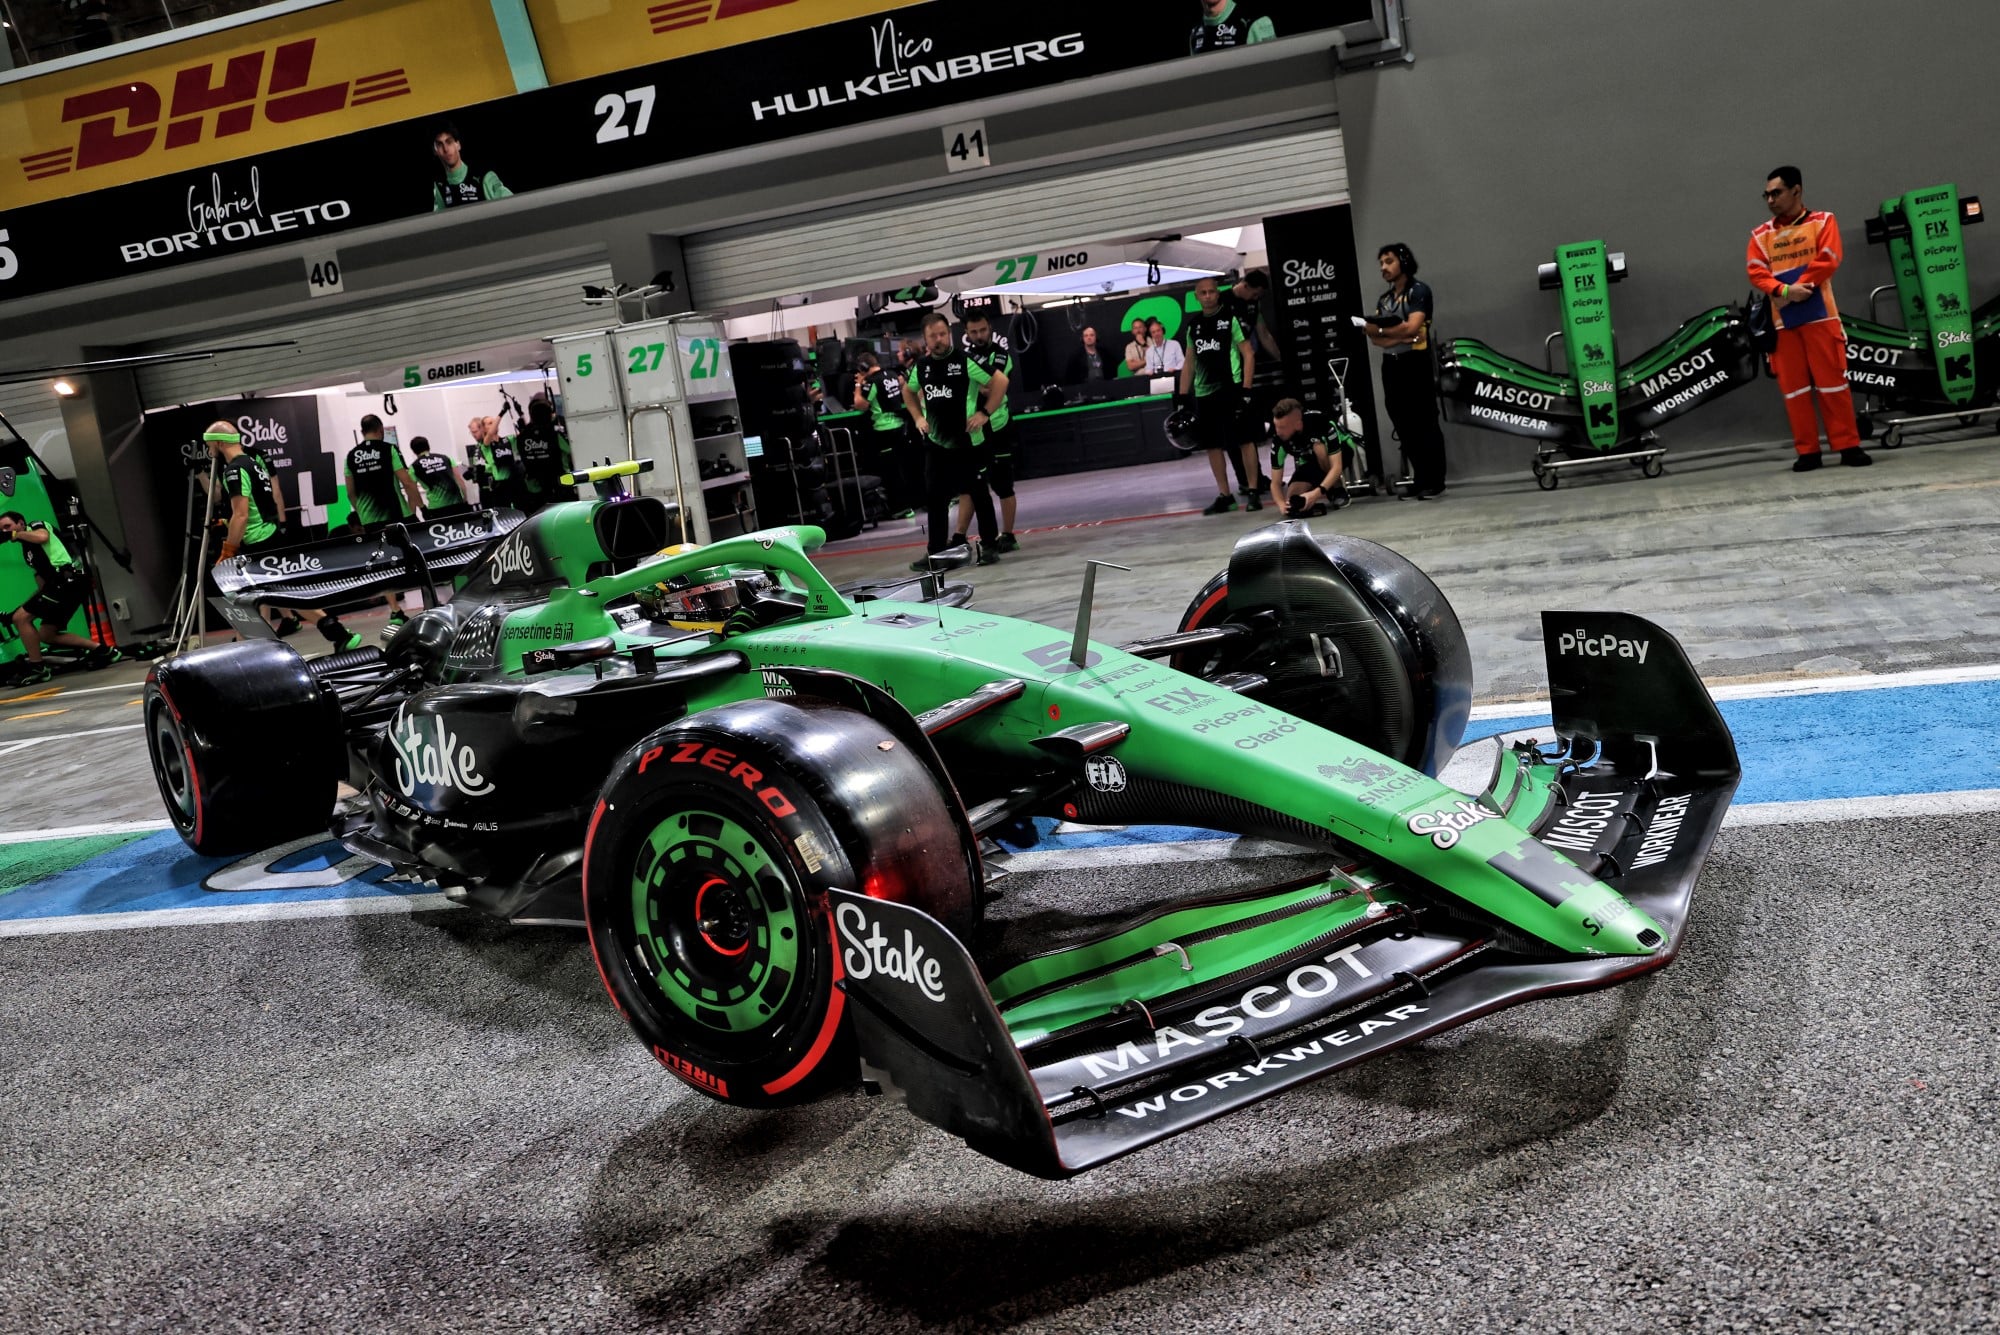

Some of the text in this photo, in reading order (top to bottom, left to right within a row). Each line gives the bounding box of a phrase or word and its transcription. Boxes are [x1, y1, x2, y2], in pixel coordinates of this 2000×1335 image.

[871, 18, 933, 76] Nico
[751, 32, 1085, 121] HULKENBERG
[61, 38, 350, 170] DHL
[594, 84, 656, 144] 27
[950, 129, 985, 161] 41
[187, 166, 263, 232] Gabriel
[120, 200, 351, 263] BORTOLETO
[1925, 220, 1949, 236] FIX
[1924, 244, 1957, 256] PicPay
[310, 260, 339, 288] 40
[995, 251, 1088, 285] 27 NICO
[1283, 259, 1336, 287] Stake
[1574, 274, 1595, 288] FIX
[1927, 260, 1959, 274] Claro
[1306, 283, 1329, 292] TEAM
[1573, 298, 1603, 308] PicPay
[1575, 313, 1602, 325] Claro
[1195, 338, 1220, 354] Stake
[1845, 344, 1903, 365] SCOT
[1937, 331, 1972, 348] Stake
[576, 353, 592, 376] 5
[628, 343, 665, 374] 27
[689, 338, 720, 379] 27
[1640, 348, 1715, 397] MASCOT
[403, 361, 485, 388] 5 GABRIEL
[1583, 380, 1614, 396] Stake
[1843, 369, 1896, 387] KWEAR
[925, 384, 952, 400] Stake
[1475, 381, 1555, 411] MASCOT
[1653, 370, 1729, 414] WORKWEAR
[237, 415, 288, 447] Stake
[1471, 404, 1548, 431] WORKWEAR
[354, 449, 380, 464] Stake
[428, 523, 487, 548] Stake
[259, 553, 323, 578] Stake
[491, 531, 534, 585] Stake
[503, 623, 551, 641] sensetime
[931, 621, 999, 643] cielo
[1559, 629, 1649, 664] PicPay
[534, 651, 556, 663] Stake
[1022, 640, 1102, 674] 5
[1078, 662, 1150, 690] PIRELLI
[1145, 687, 1213, 712] FIX
[1171, 697, 1222, 716] NETWORK
[1192, 704, 1267, 734] PicPay
[388, 700, 496, 797] Stake
[1234, 719, 1298, 750] Claro
[638, 743, 797, 818] P ZERO
[1357, 771, 1424, 806] SINGHA
[1541, 791, 1624, 852] MASCOT
[1630, 793, 1692, 870] WORKWEAR
[836, 902, 945, 1001] Stake
[1080, 943, 1375, 1079] MASCOT
[653, 1044, 729, 1098] PIRELLI
[1116, 1002, 1430, 1119] WORKWEAR
